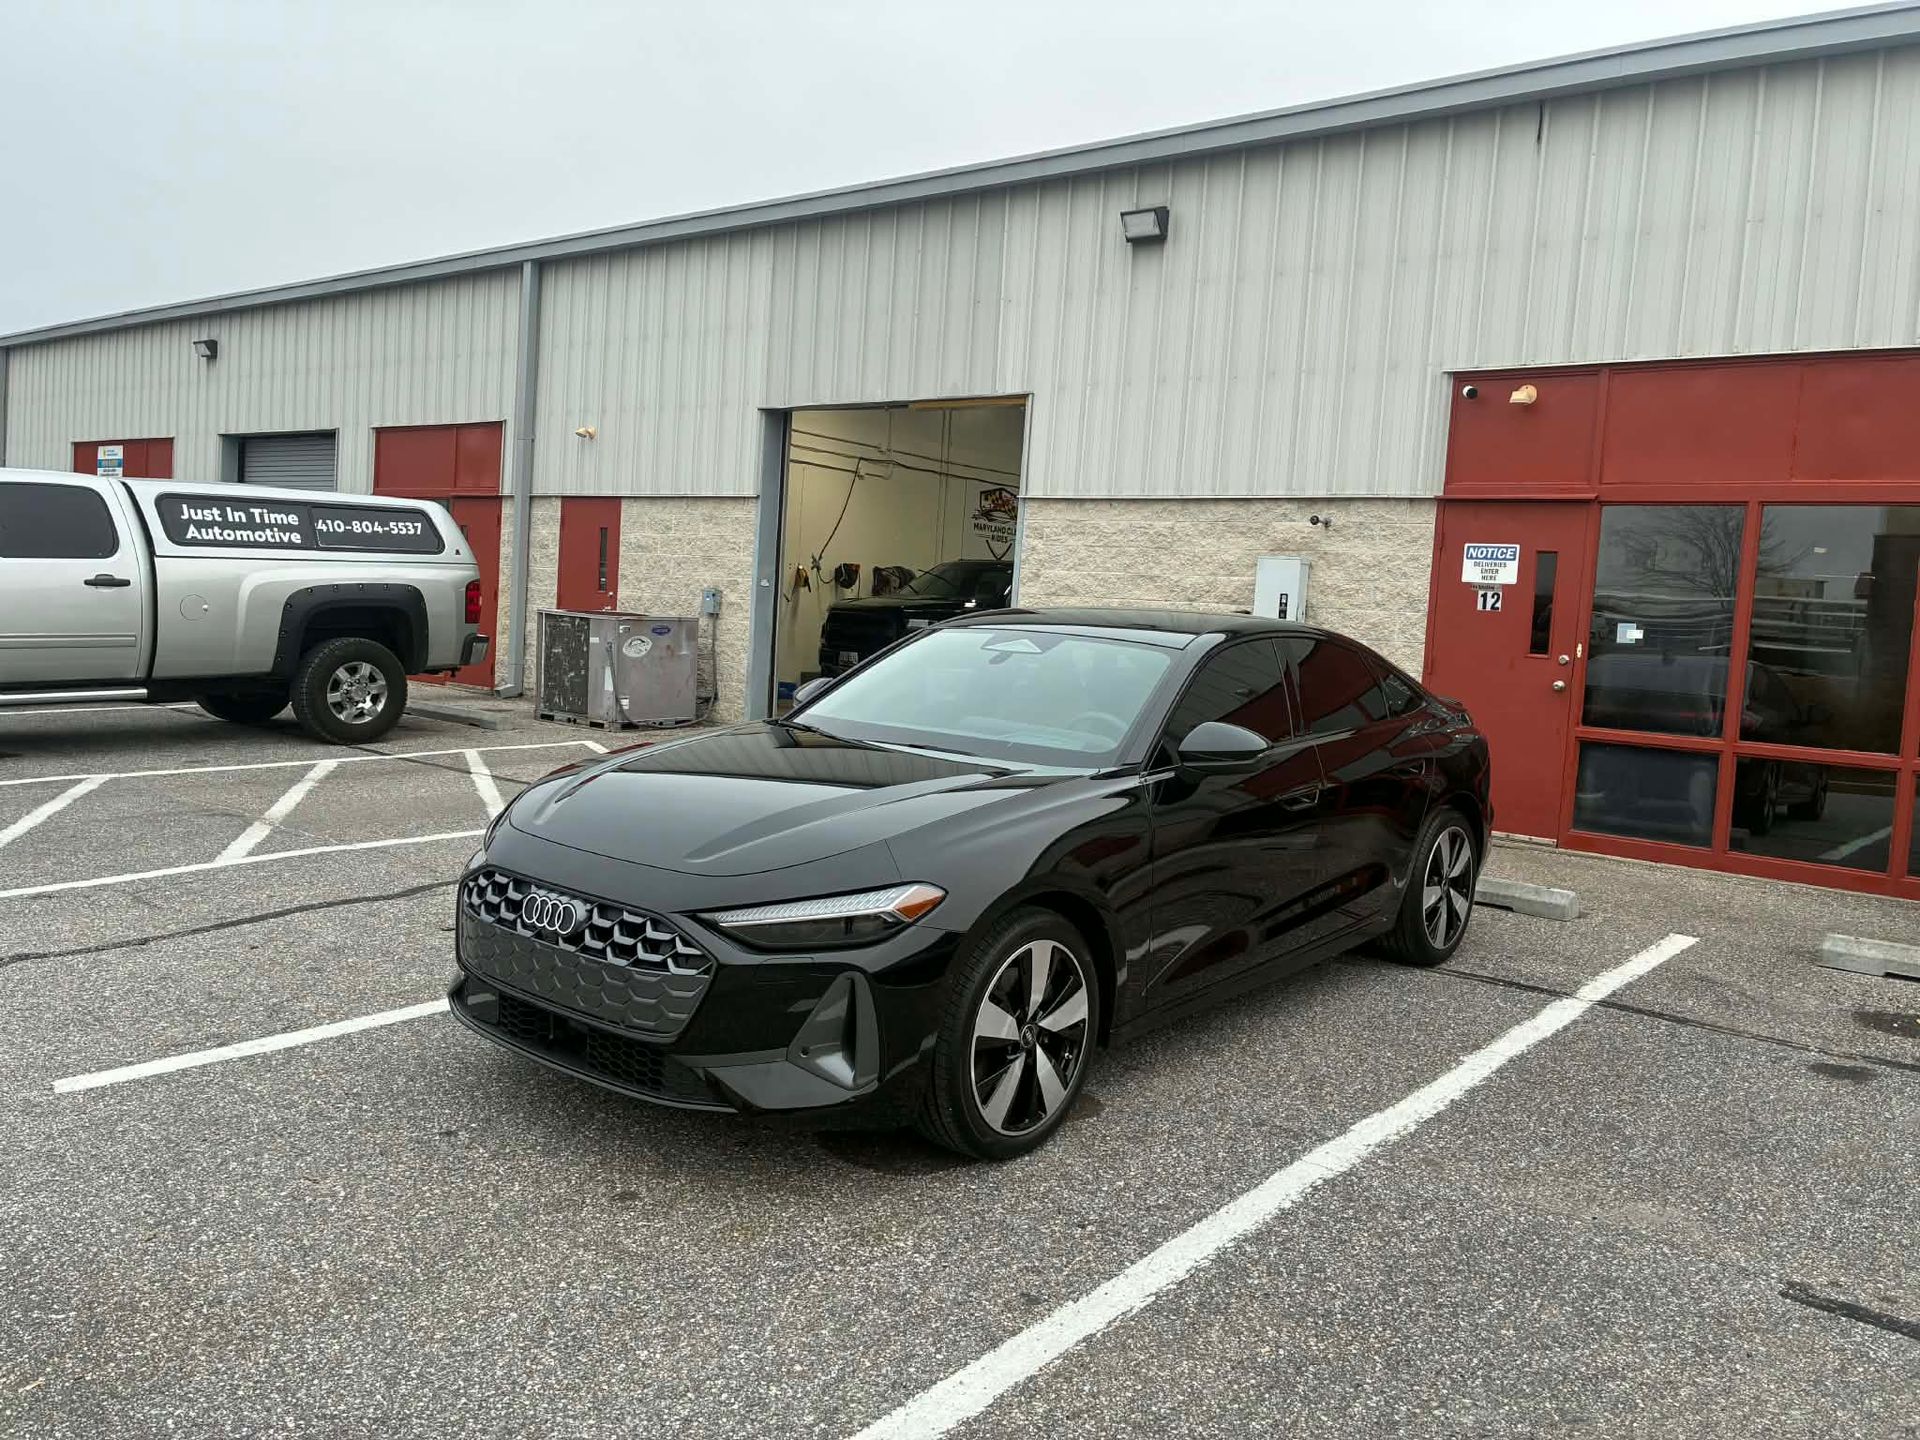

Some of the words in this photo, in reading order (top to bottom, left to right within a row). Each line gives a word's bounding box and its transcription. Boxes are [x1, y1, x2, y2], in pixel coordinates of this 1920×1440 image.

[180, 503, 222, 521] Just
[225, 506, 246, 523] In
[249, 508, 299, 525] Time
[185, 523, 302, 544] Automotive
[316, 519, 422, 535] 410-804-5537
[974, 522, 1007, 535] MARYLAND
[992, 534, 1008, 543] RIDES
[1467, 547, 1516, 559] NOTICE
[1480, 592, 1501, 611] 12
